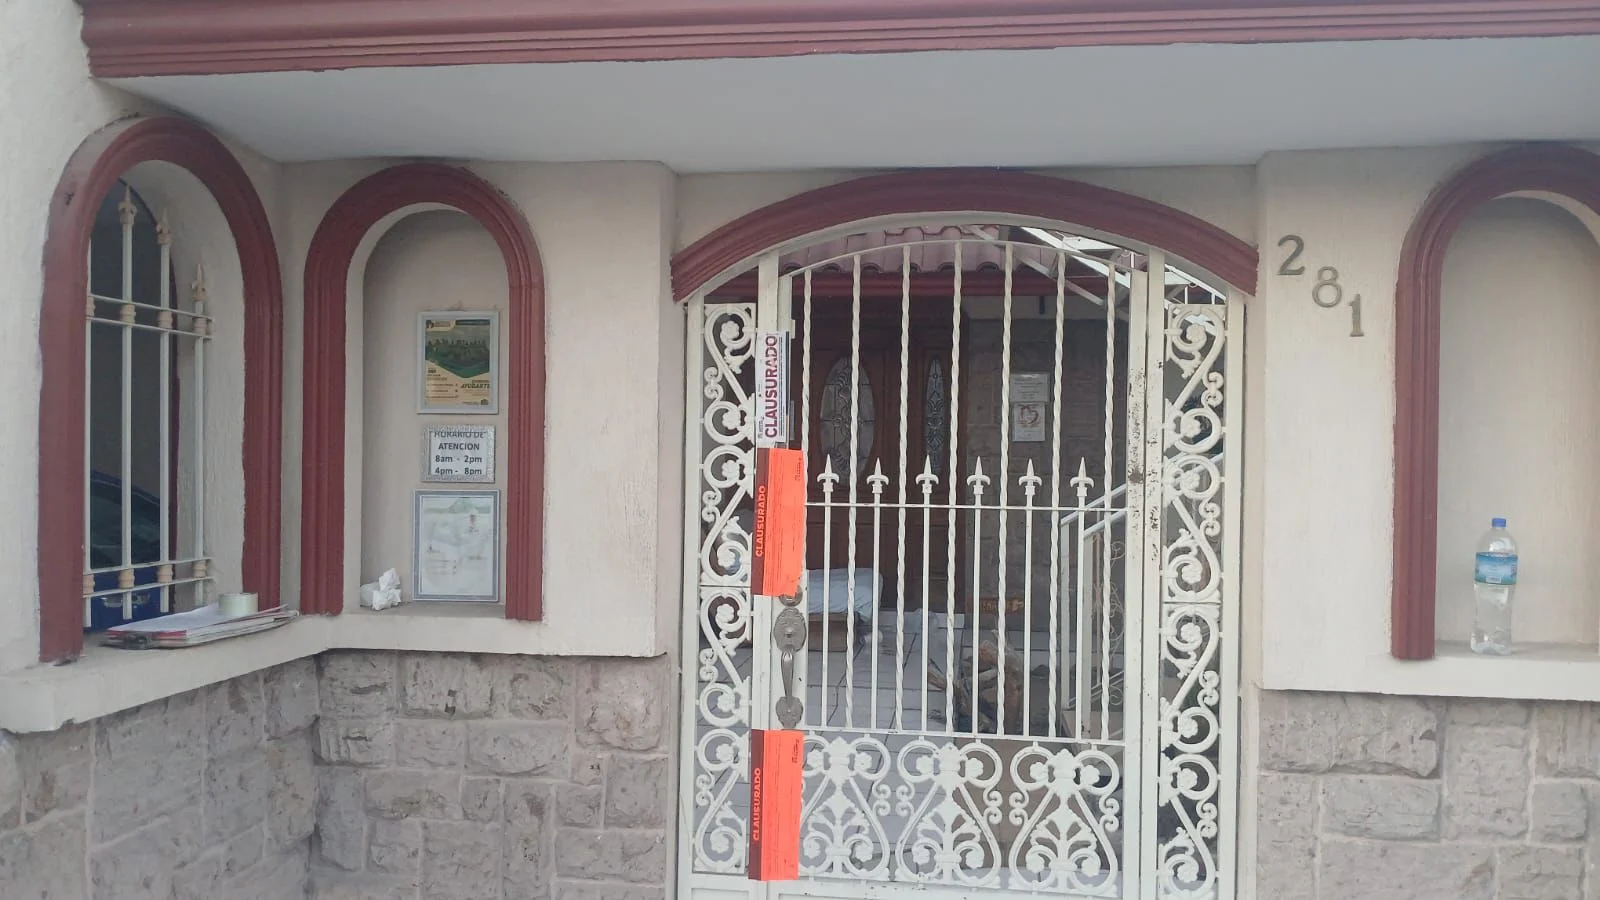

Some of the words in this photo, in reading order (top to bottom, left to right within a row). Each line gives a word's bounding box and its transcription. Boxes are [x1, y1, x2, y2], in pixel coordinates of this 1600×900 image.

[1276, 234, 1364, 337] 281
[764, 335, 778, 438] CLAUSURADO
[435, 454, 453, 463] 8am
[464, 455, 482, 464] 2pm
[435, 467, 453, 475] 4pm
[464, 467, 482, 475] 8pm
[438, 442, 480, 451] ATENCION
[755, 485, 766, 557] CLAUSURADO
[753, 767, 761, 841] CLAUSURADO
